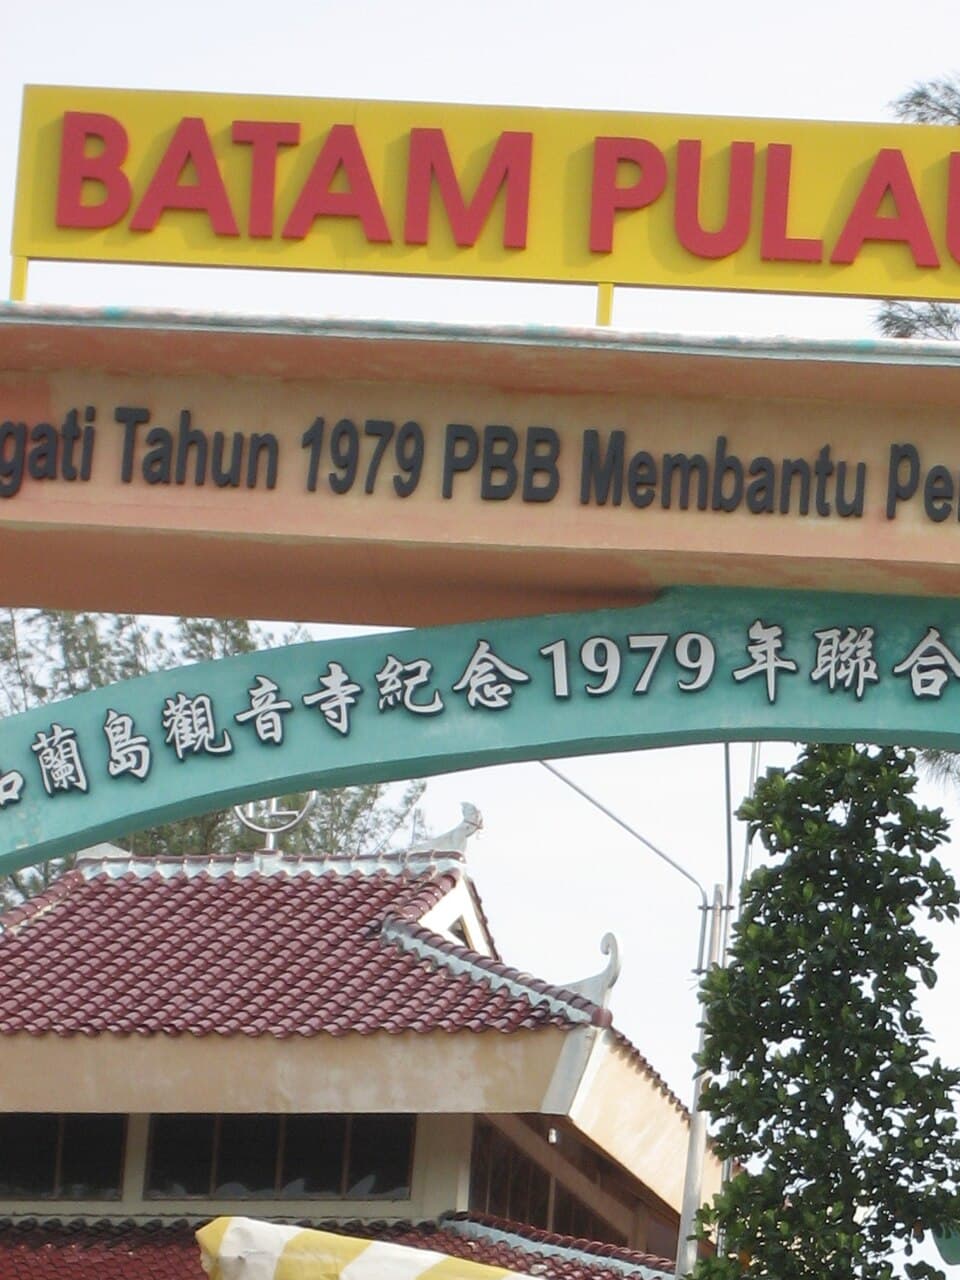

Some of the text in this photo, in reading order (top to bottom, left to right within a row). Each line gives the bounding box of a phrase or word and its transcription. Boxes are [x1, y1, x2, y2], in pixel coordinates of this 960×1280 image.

[56, 110, 533, 250] BATAM
[115, 407, 278, 490] Tahun
[301, 417, 422, 497] 1979
[442, 423, 561, 503] PBB
[580, 428, 867, 518] Membantu
